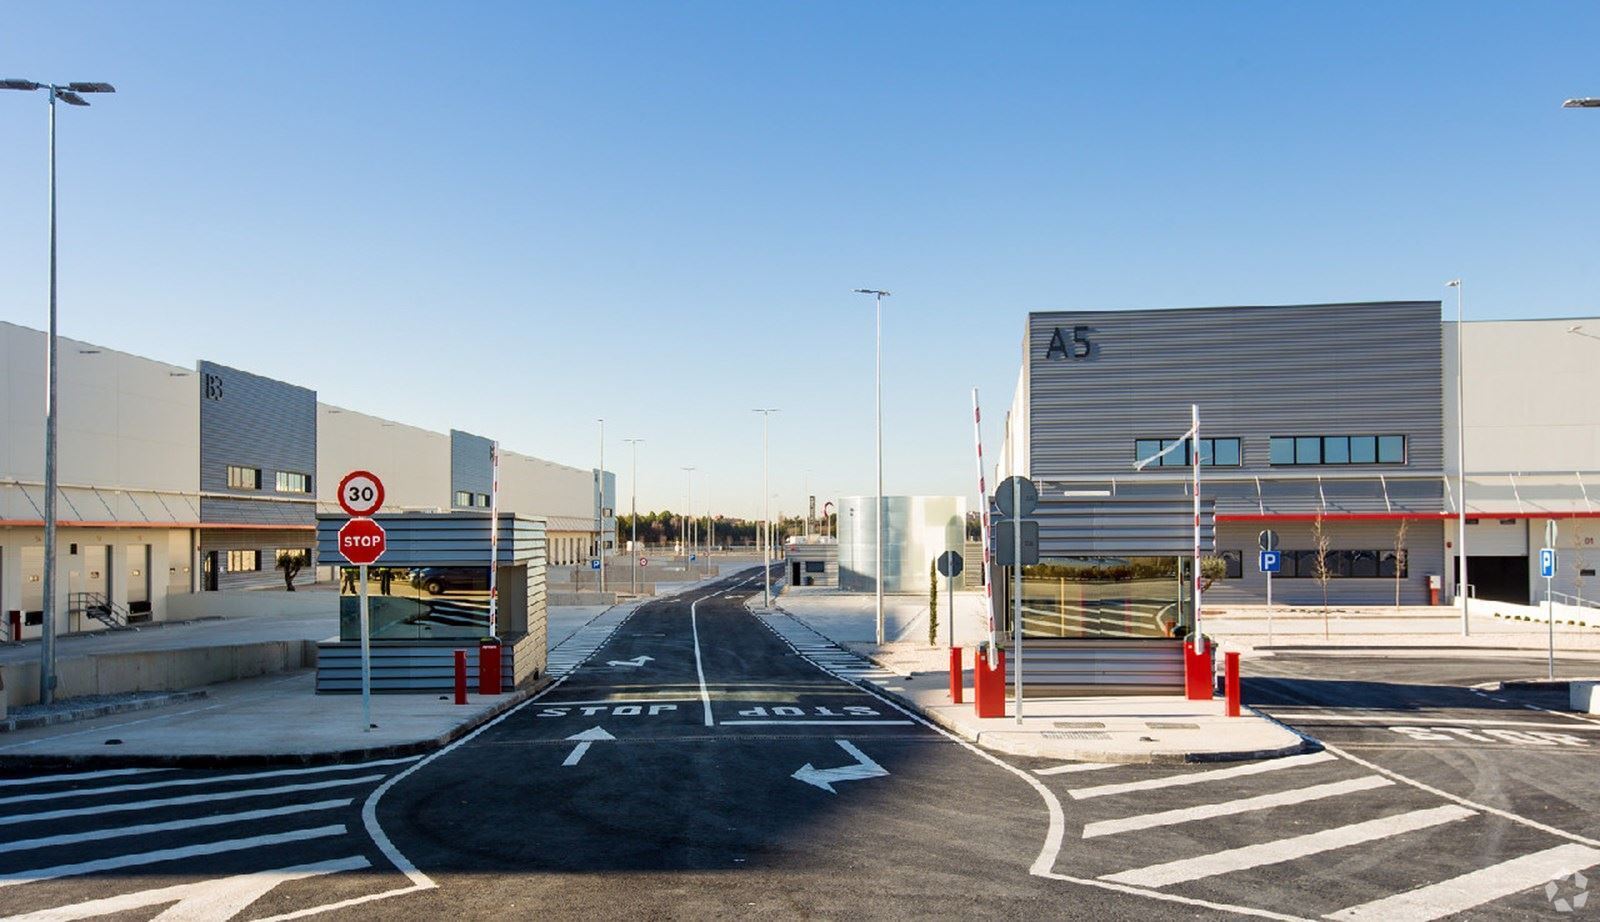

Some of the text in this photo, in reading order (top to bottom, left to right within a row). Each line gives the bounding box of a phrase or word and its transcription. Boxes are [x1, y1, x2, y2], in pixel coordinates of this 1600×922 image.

[205, 373, 223, 401] B3
[348, 486, 374, 502] 30
[344, 535, 381, 547] STOP
[1264, 553, 1276, 570] P
[536, 704, 678, 717] STOP
[738, 706, 881, 717] STOP
